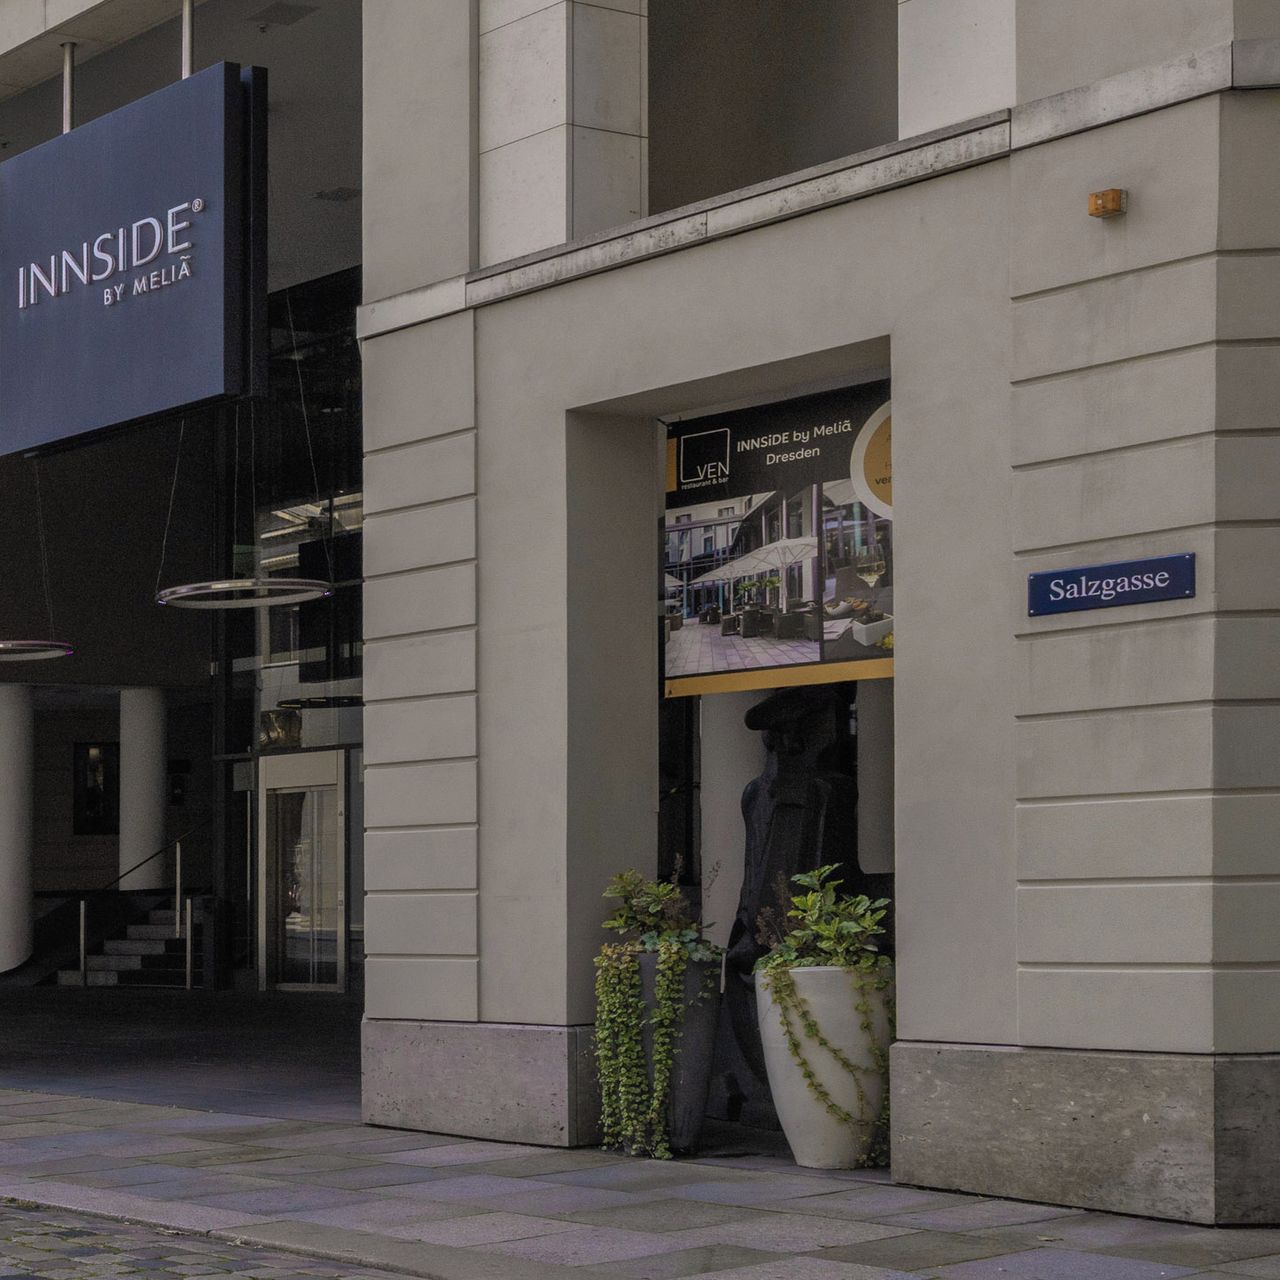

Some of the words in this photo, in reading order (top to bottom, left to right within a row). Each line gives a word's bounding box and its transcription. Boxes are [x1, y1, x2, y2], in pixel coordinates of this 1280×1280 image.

[103, 282, 125, 307] BY
[793, 429, 810, 443] by
[765, 447, 821, 466] Dresden
[696, 462, 730, 480] VEN
[681, 480, 711, 491] restaurant
[1049, 571, 1170, 601] Salzgasse
